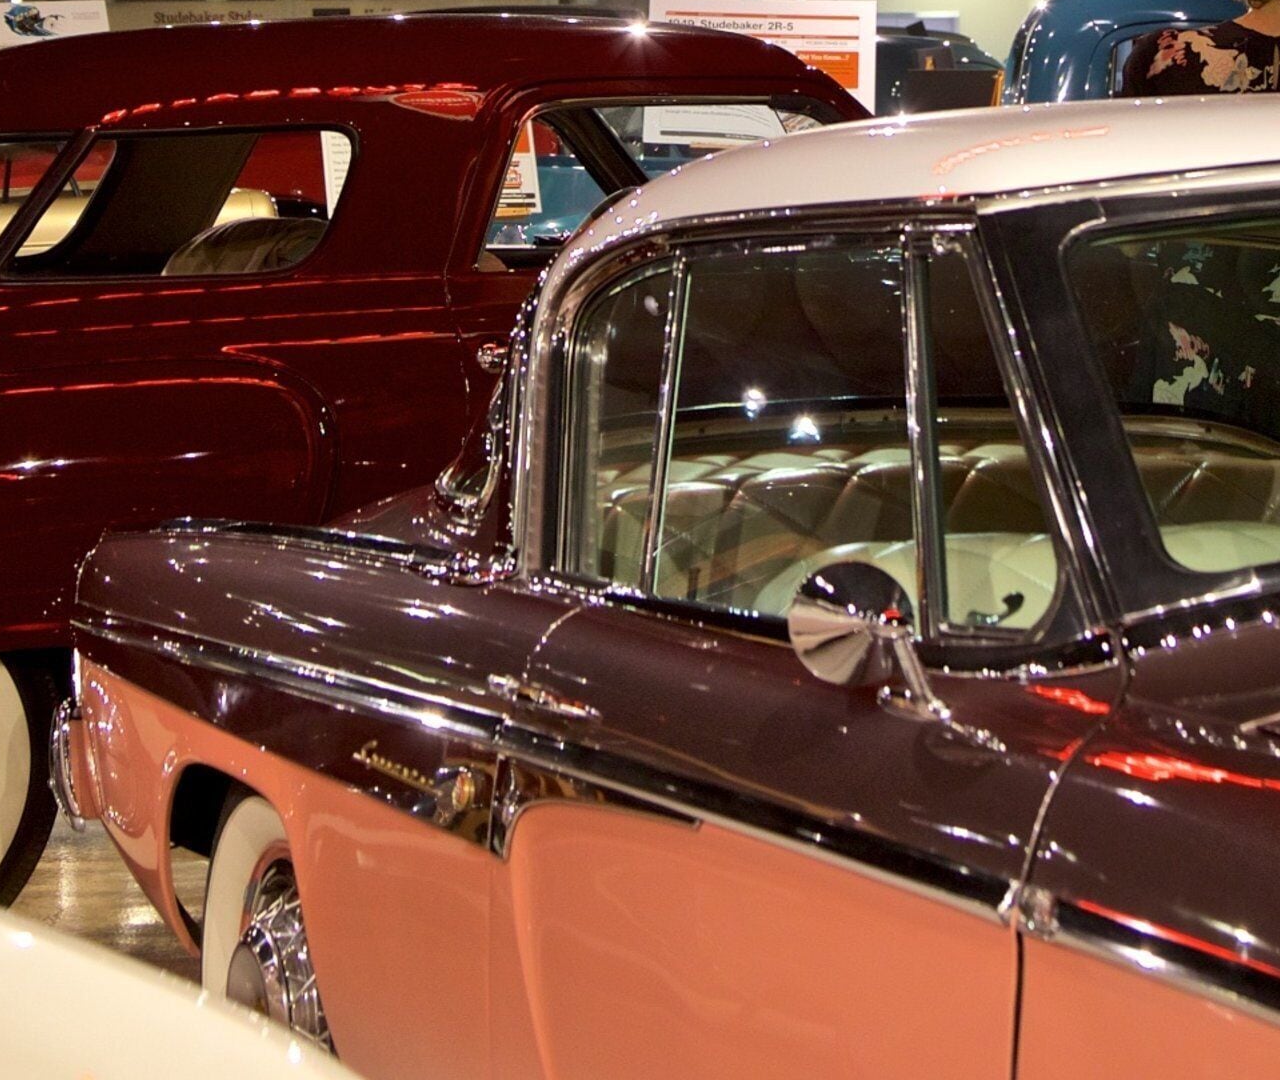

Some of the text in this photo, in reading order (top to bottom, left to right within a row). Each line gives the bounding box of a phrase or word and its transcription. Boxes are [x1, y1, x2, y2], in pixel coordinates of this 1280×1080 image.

[153, 11, 224, 23] Studebaker
[700, 19, 763, 30] Studebaker
[768, 22, 794, 31] 2R-5
